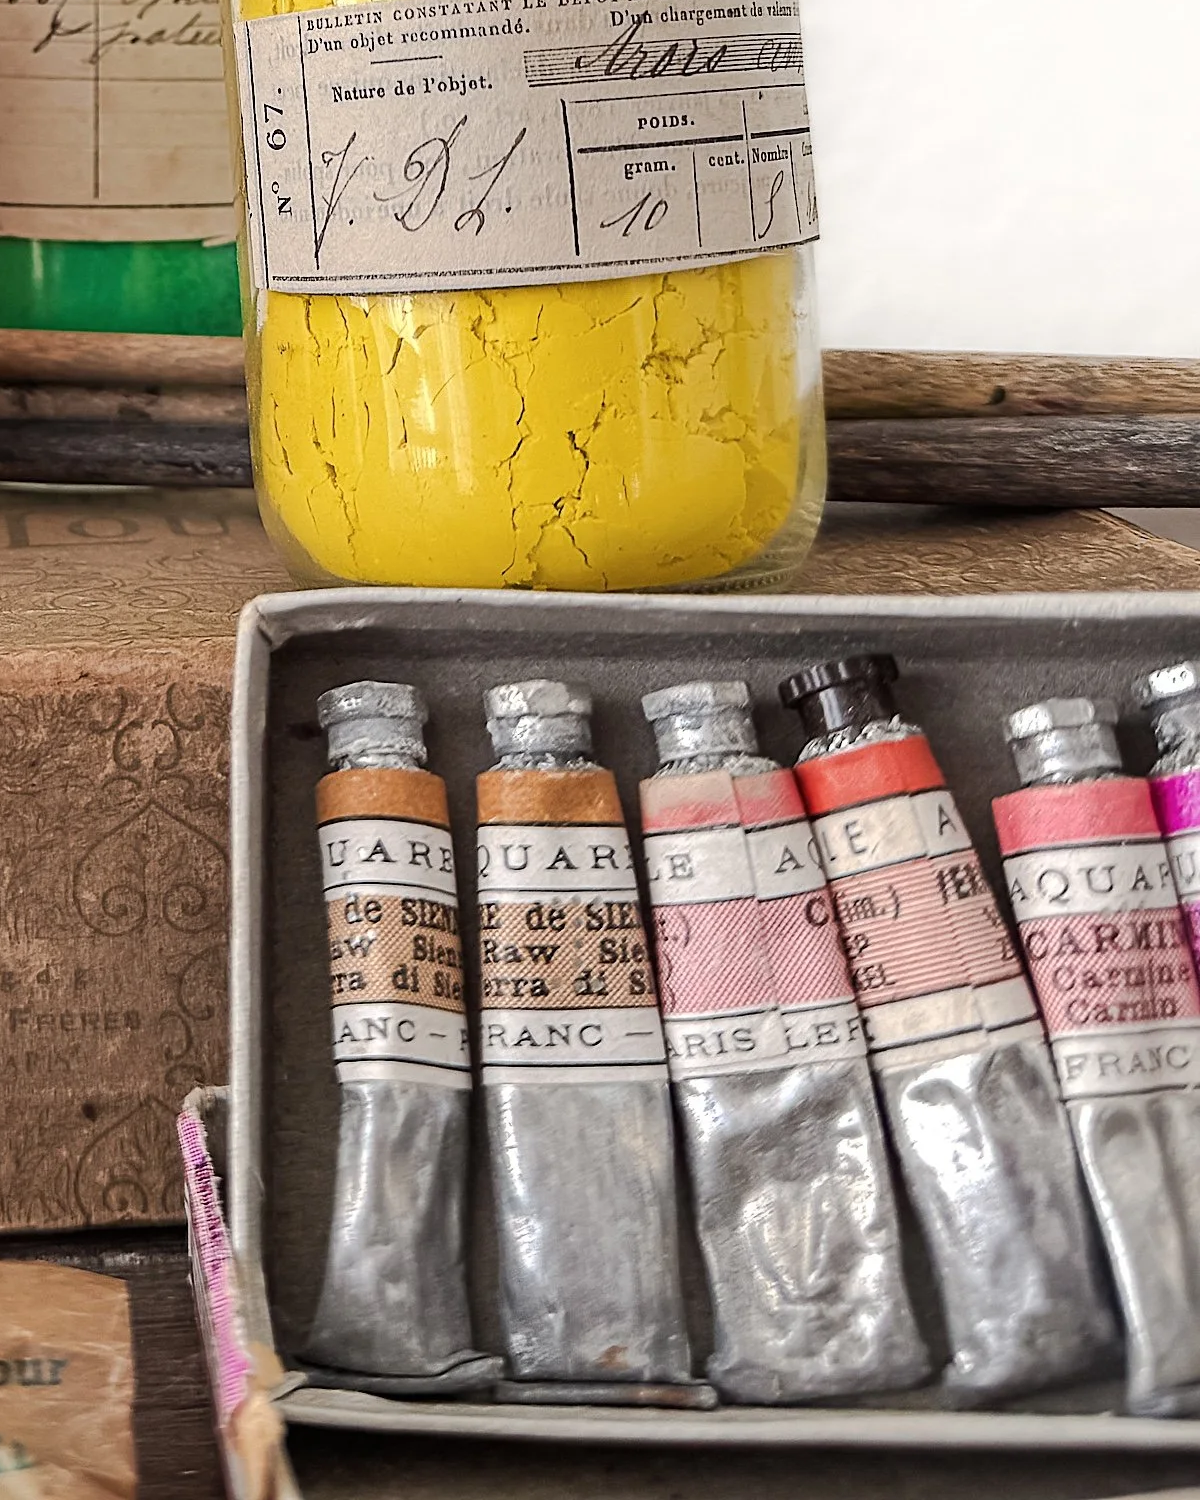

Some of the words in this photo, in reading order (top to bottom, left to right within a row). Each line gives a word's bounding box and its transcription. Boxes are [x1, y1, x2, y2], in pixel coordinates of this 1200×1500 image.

[306, 10, 383, 31] BULLETIN
[393, 0, 513, 21] CONSTATANT
[611, 10, 653, 27] D'un
[660, 2, 747, 26] chargement
[750, 2, 763, 17] de
[308, 38, 342, 55] D'un
[350, 32, 394, 52] objet
[401, 18, 530, 45] recommandé.
[331, 84, 386, 102] Nature
[394, 80, 415, 97] de
[422, 74, 493, 97] l'objet.
[637, 114, 695, 130] POIDS.
[623, 160, 676, 180] gram.
[708, 150, 745, 167] cent.
[346, 893, 383, 924] de
[525, 902, 567, 931] de
[483, 938, 560, 965] Raw
